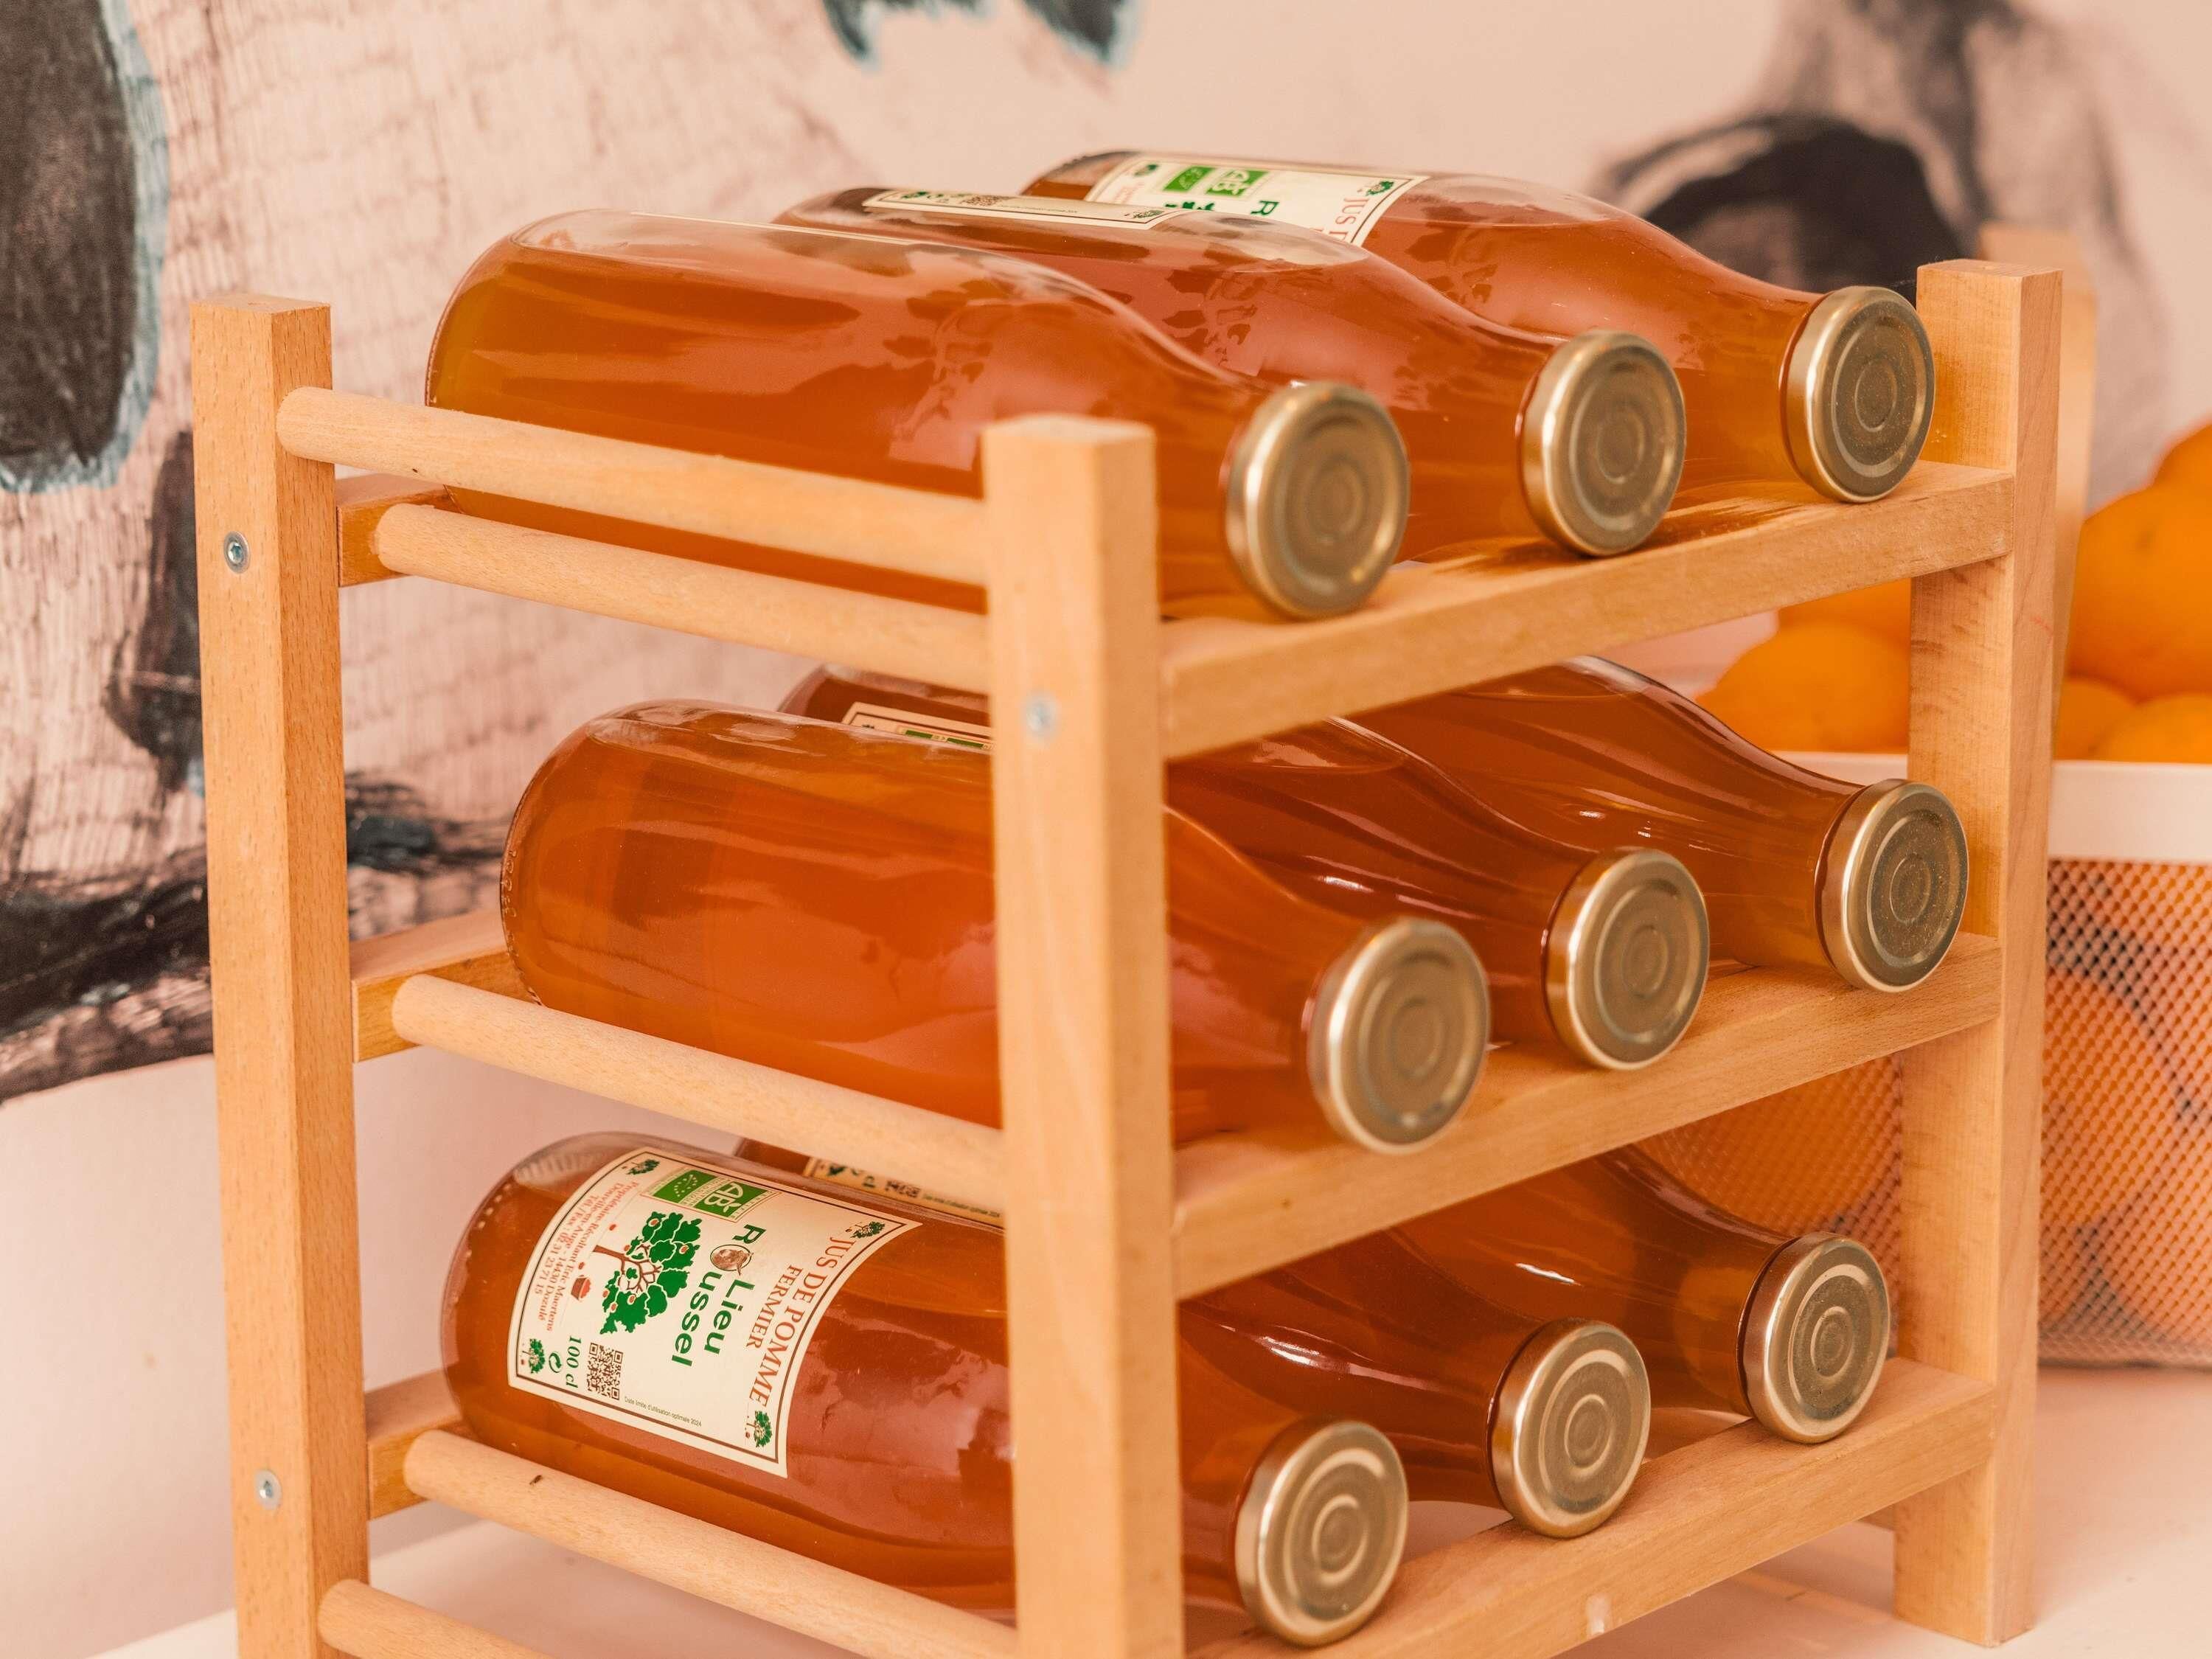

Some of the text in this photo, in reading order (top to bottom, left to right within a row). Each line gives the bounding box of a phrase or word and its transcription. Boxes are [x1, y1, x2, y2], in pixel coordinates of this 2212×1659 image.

[1335, 198, 1369, 224] JUS
[704, 1181, 743, 1207] AB
[550, 1242, 562, 1254] 31
[539, 1269, 550, 1281] 71
[545, 1256, 555, 1268] 23
[561, 1265, 574, 1284] Eric
[535, 1284, 543, 1294] 15
[538, 1285, 554, 1321] Dozulé
[547, 1286, 566, 1332] Maertens
[746, 1265, 804, 1349] FERMIER
[704, 1279, 755, 1354] Lieu
[749, 1237, 857, 1407] JUS DE POMME
[566, 1335, 581, 1388] 100 cl
